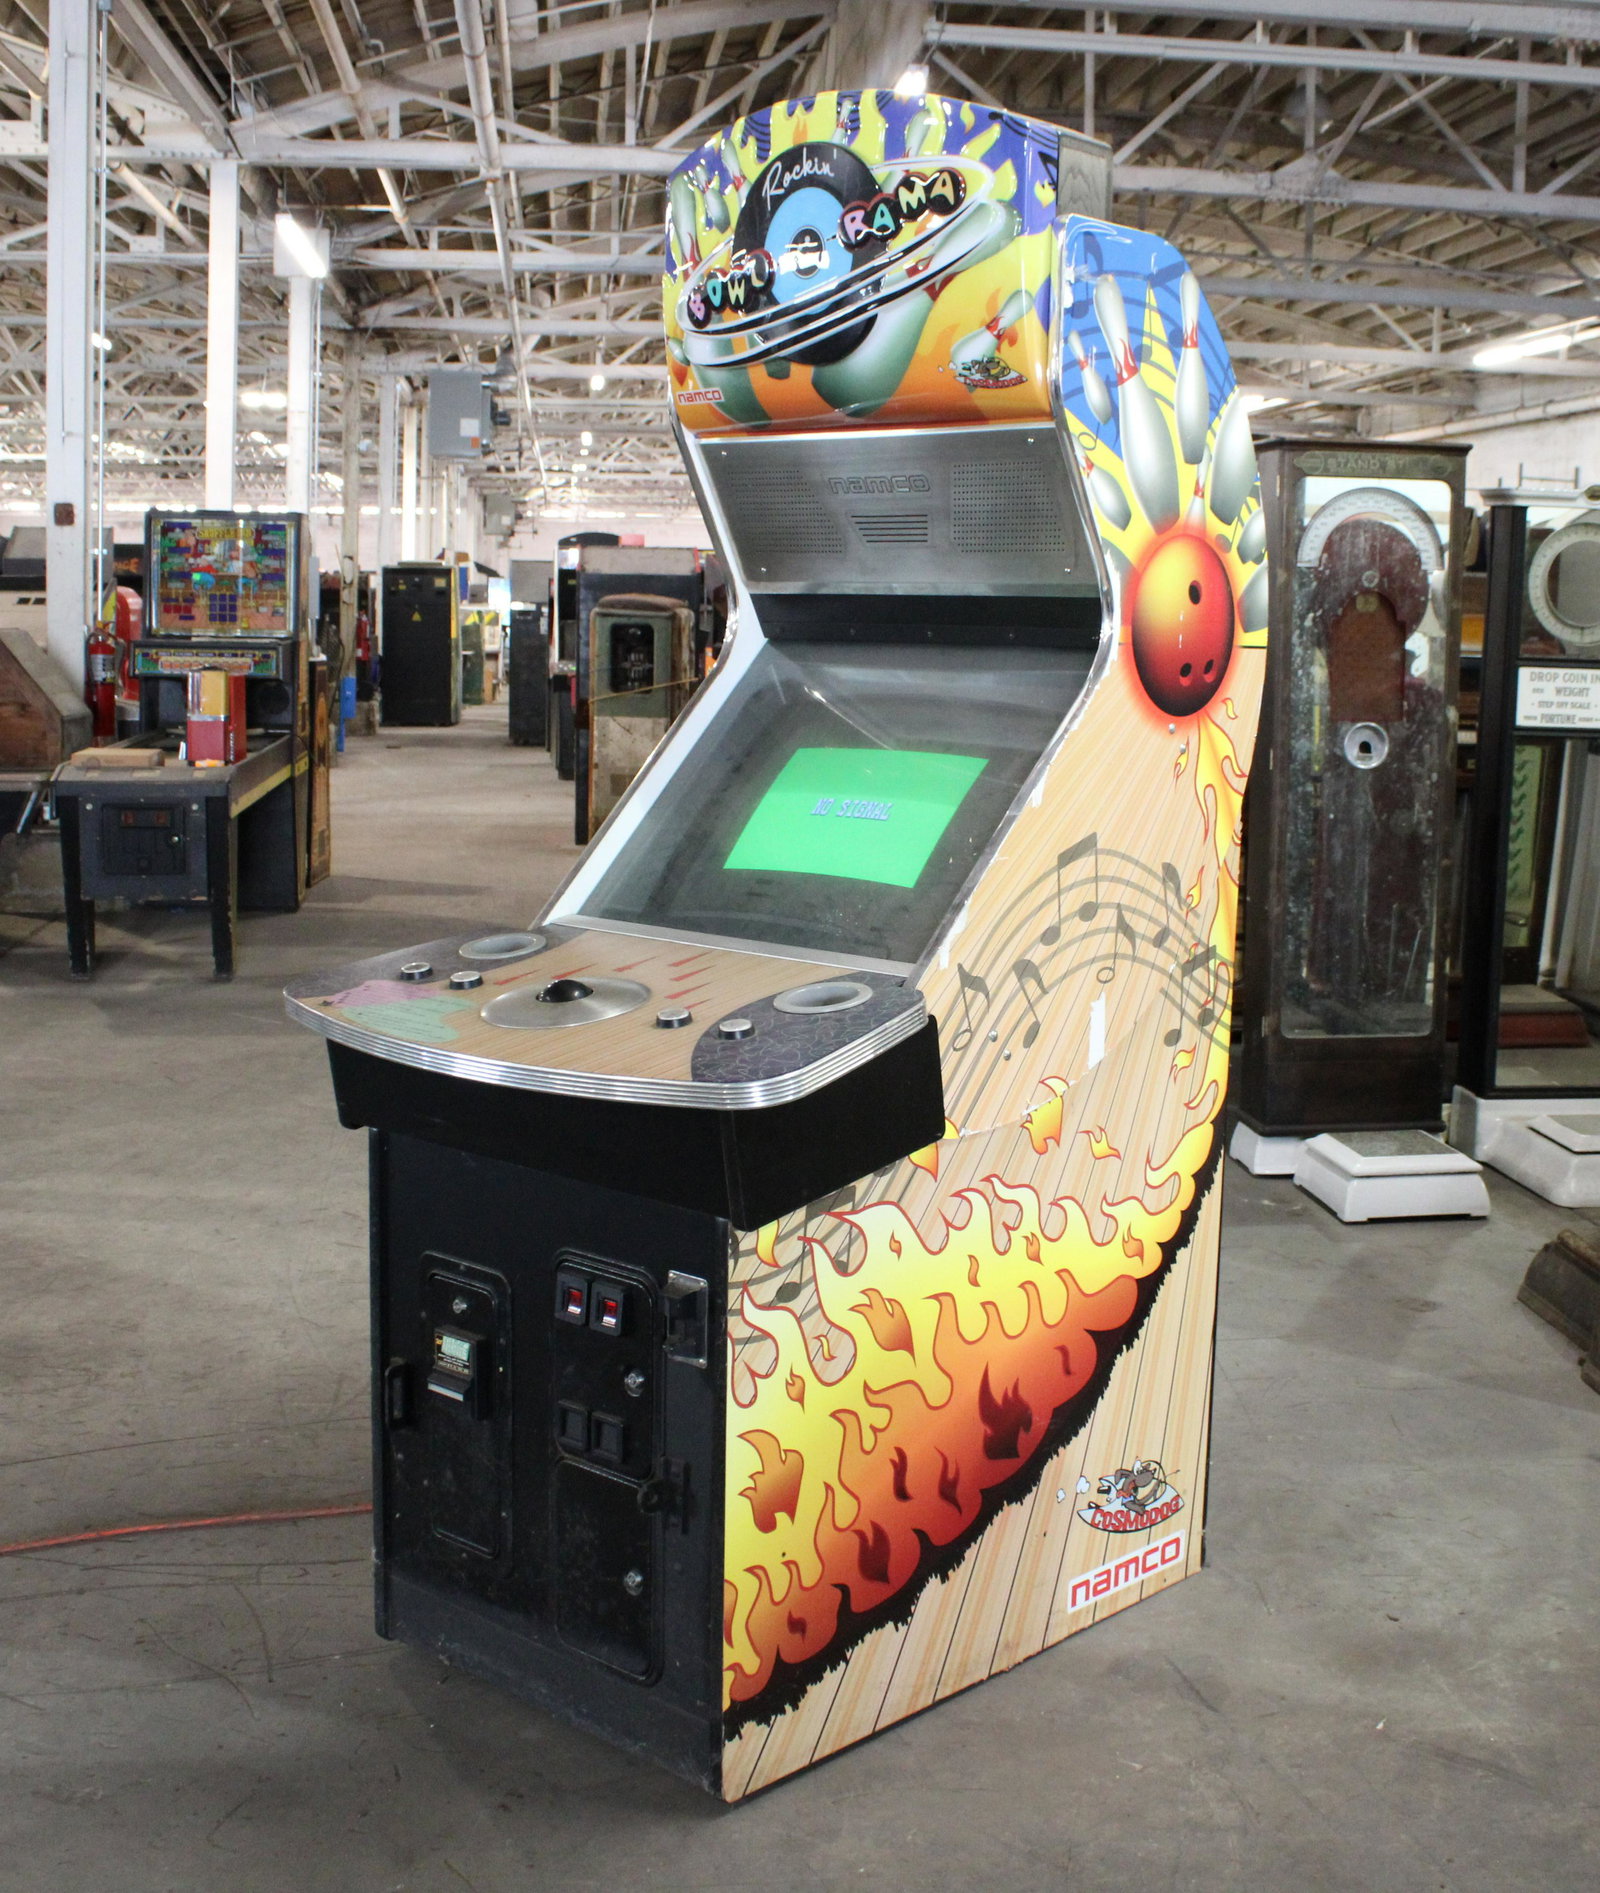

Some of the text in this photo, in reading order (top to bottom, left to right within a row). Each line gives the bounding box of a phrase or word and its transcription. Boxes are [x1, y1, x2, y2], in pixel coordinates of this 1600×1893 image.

[762, 147, 837, 211] Rockin'
[843, 171, 955, 245] RAMA
[678, 390, 723, 403] namco
[828, 474, 931, 495] namco
[1530, 671, 1559, 682] DROP
[1562, 672, 1588, 683] COIN
[1555, 686, 1590, 697] WEIGHT
[1540, 713, 1576, 725] FORTUNE
[810, 798, 893, 821] NO SIGNAL
[1090, 1495, 1181, 1532] COSMODOG
[1070, 1536, 1181, 1609] namco
